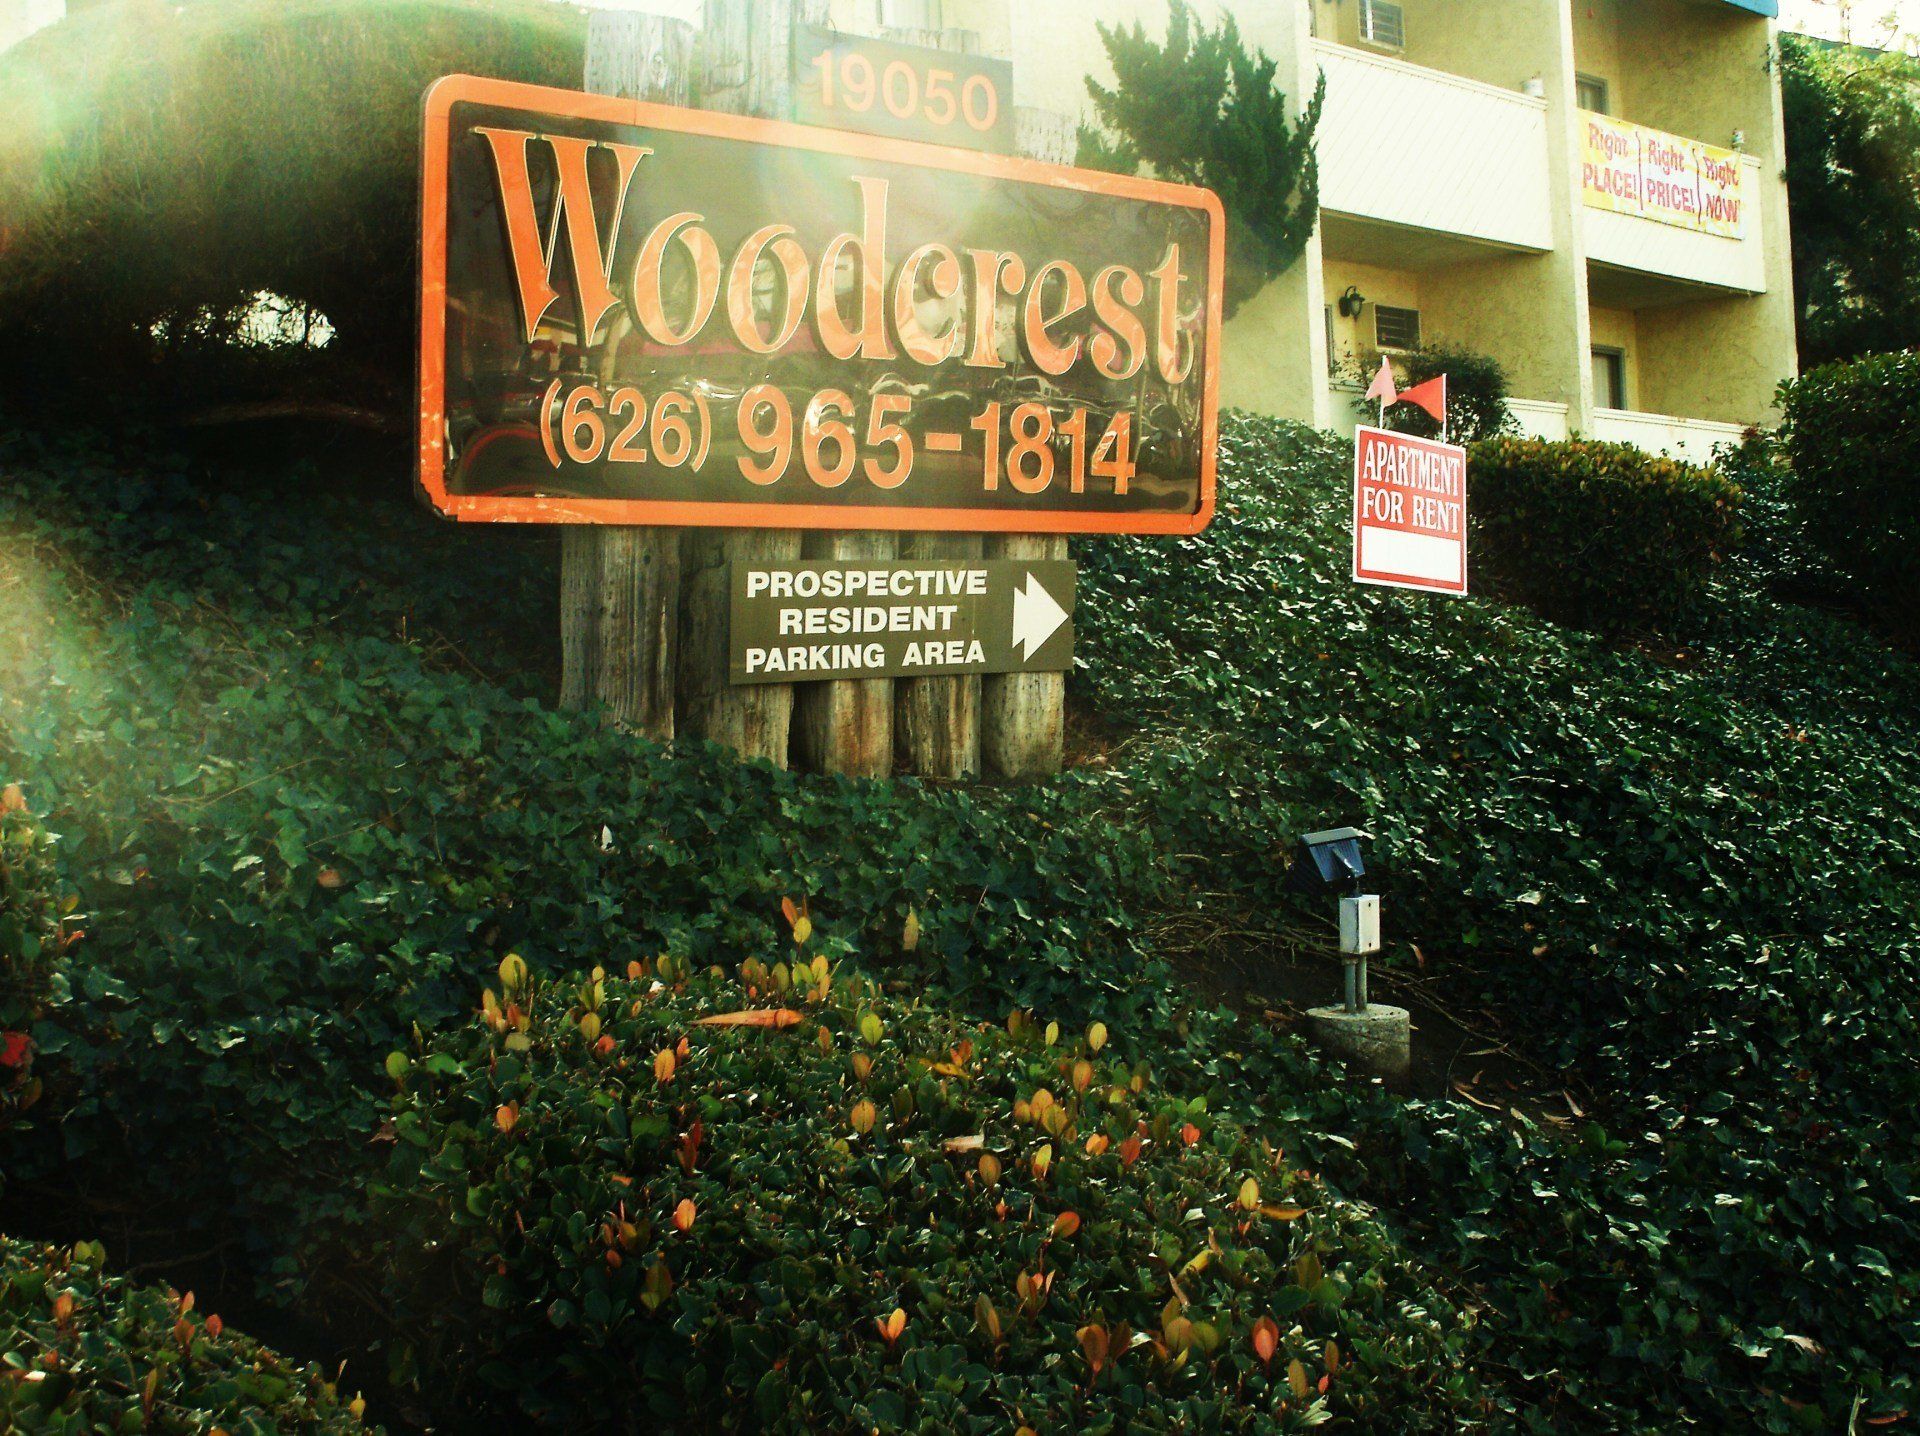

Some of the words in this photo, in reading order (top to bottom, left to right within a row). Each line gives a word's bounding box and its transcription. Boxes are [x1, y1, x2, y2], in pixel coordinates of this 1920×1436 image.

[812, 50, 997, 131] 19050
[1588, 122, 1628, 160] Right
[1648, 139, 1684, 175] Right
[1583, 162, 1637, 200] PLACE!
[1703, 156, 1739, 189] Right
[1646, 178, 1695, 213] PRICE!
[472, 126, 1200, 385] Woodcrest
[539, 378, 711, 473] (626)
[737, 384, 1137, 496] 965-1814
[1362, 439, 1461, 497] APARTMENT
[1362, 486, 1404, 524] FOR
[1412, 495, 1461, 534] RENT
[747, 570, 988, 598] PROSPECTIVE
[779, 605, 957, 635] RESIDENT
[746, 644, 885, 673] PARKING
[902, 640, 986, 667] AREA
